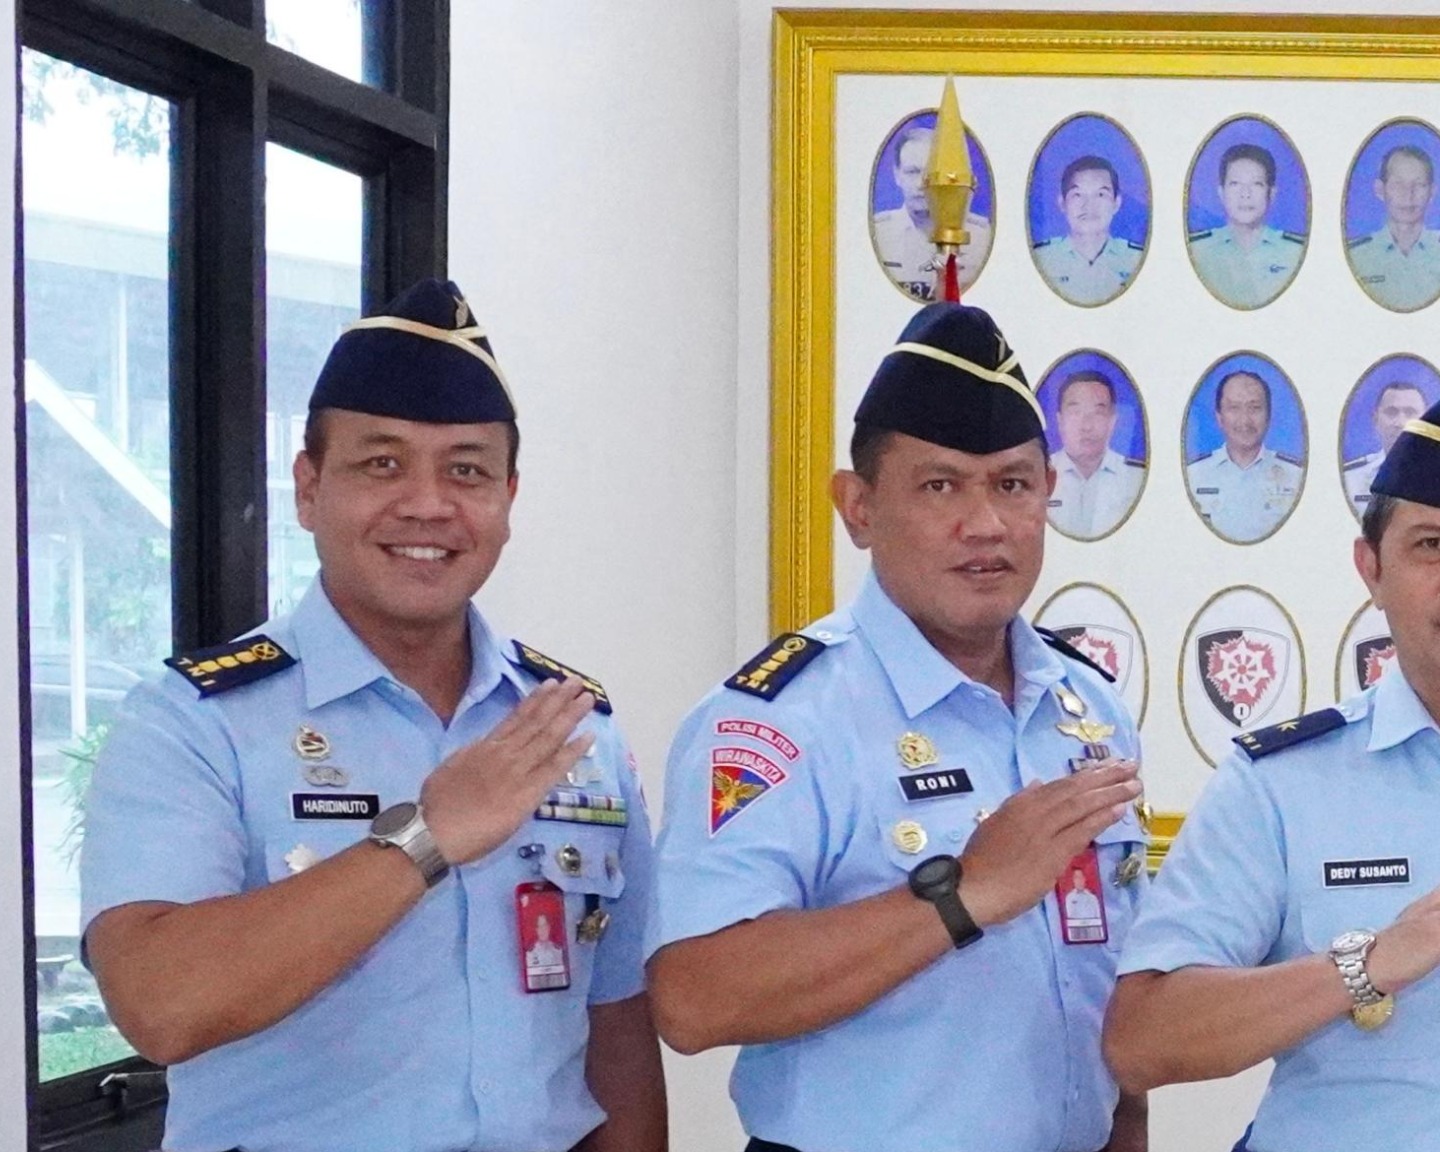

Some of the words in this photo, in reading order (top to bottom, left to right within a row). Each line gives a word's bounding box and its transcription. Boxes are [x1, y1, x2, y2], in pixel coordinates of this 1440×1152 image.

[915, 774, 957, 791] RONI
[1330, 867, 1357, 880] DEDY
[1359, 864, 1407, 878] SUSANTO
